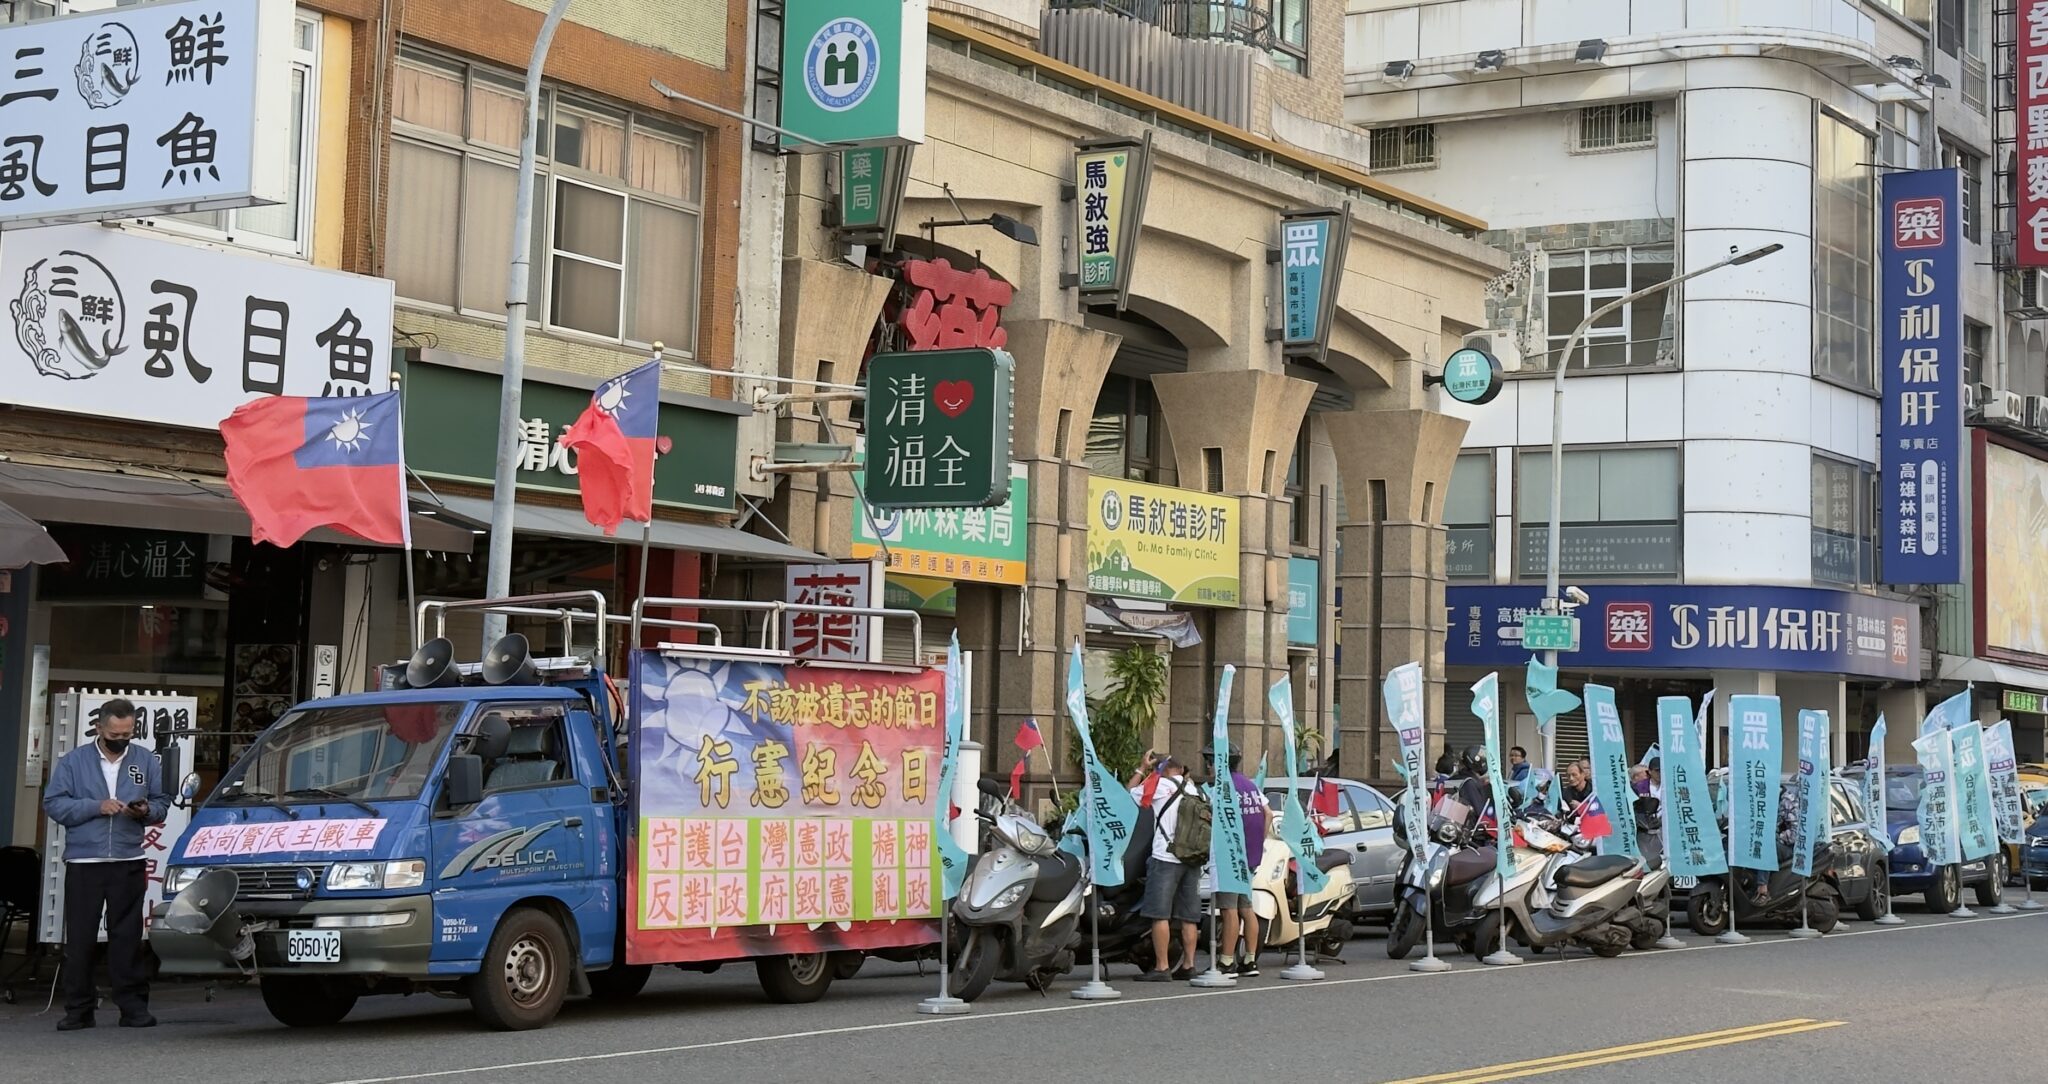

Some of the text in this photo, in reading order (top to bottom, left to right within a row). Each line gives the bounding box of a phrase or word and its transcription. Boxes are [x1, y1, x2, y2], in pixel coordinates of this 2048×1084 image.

[0, 11, 229, 106] 三 鮮
[95, 33, 132, 67] 三鮮
[852, 153, 872, 211] 藥局
[1084, 160, 1110, 255] 馬敘強
[1898, 206, 1940, 241] 藥
[1287, 224, 1320, 268] 眾
[1084, 261, 1111, 284] 診所
[50, 266, 114, 325] 三鮮
[1459, 354, 1478, 377] 眾
[1899, 304, 1941, 426] 利保肝
[886, 373, 925, 427] 清
[884, 435, 971, 487] 福全
[1900, 438, 1938, 450] 專賣店
[1127, 495, 1227, 545] 馬敘強診所
[1900, 462, 1917, 555] 高雄林森店
[86, 540, 196, 579] 清心福全
[1137, 541, 1218, 561] Dr. Ma Family Clinic
[1469, 606, 1482, 647] 專賣店
[1535, 635, 1549, 647] 43
[1609, 610, 1648, 643] 藥
[1707, 605, 1842, 652] 利保肝
[743, 680, 937, 729] 不該被遺忘的節日
[1743, 711, 1769, 750] 眾
[694, 735, 929, 809] 行憲紀念日
[1676, 764, 1707, 865] 台灣民眾黨
[1752, 760, 1766, 860] 台灣民眾黨
[189, 820, 377, 854] 徐尚賢民主戰車
[486, 850, 558, 868] DELICA
[500, 862, 585, 876] MULTI-POINT INJECTION
